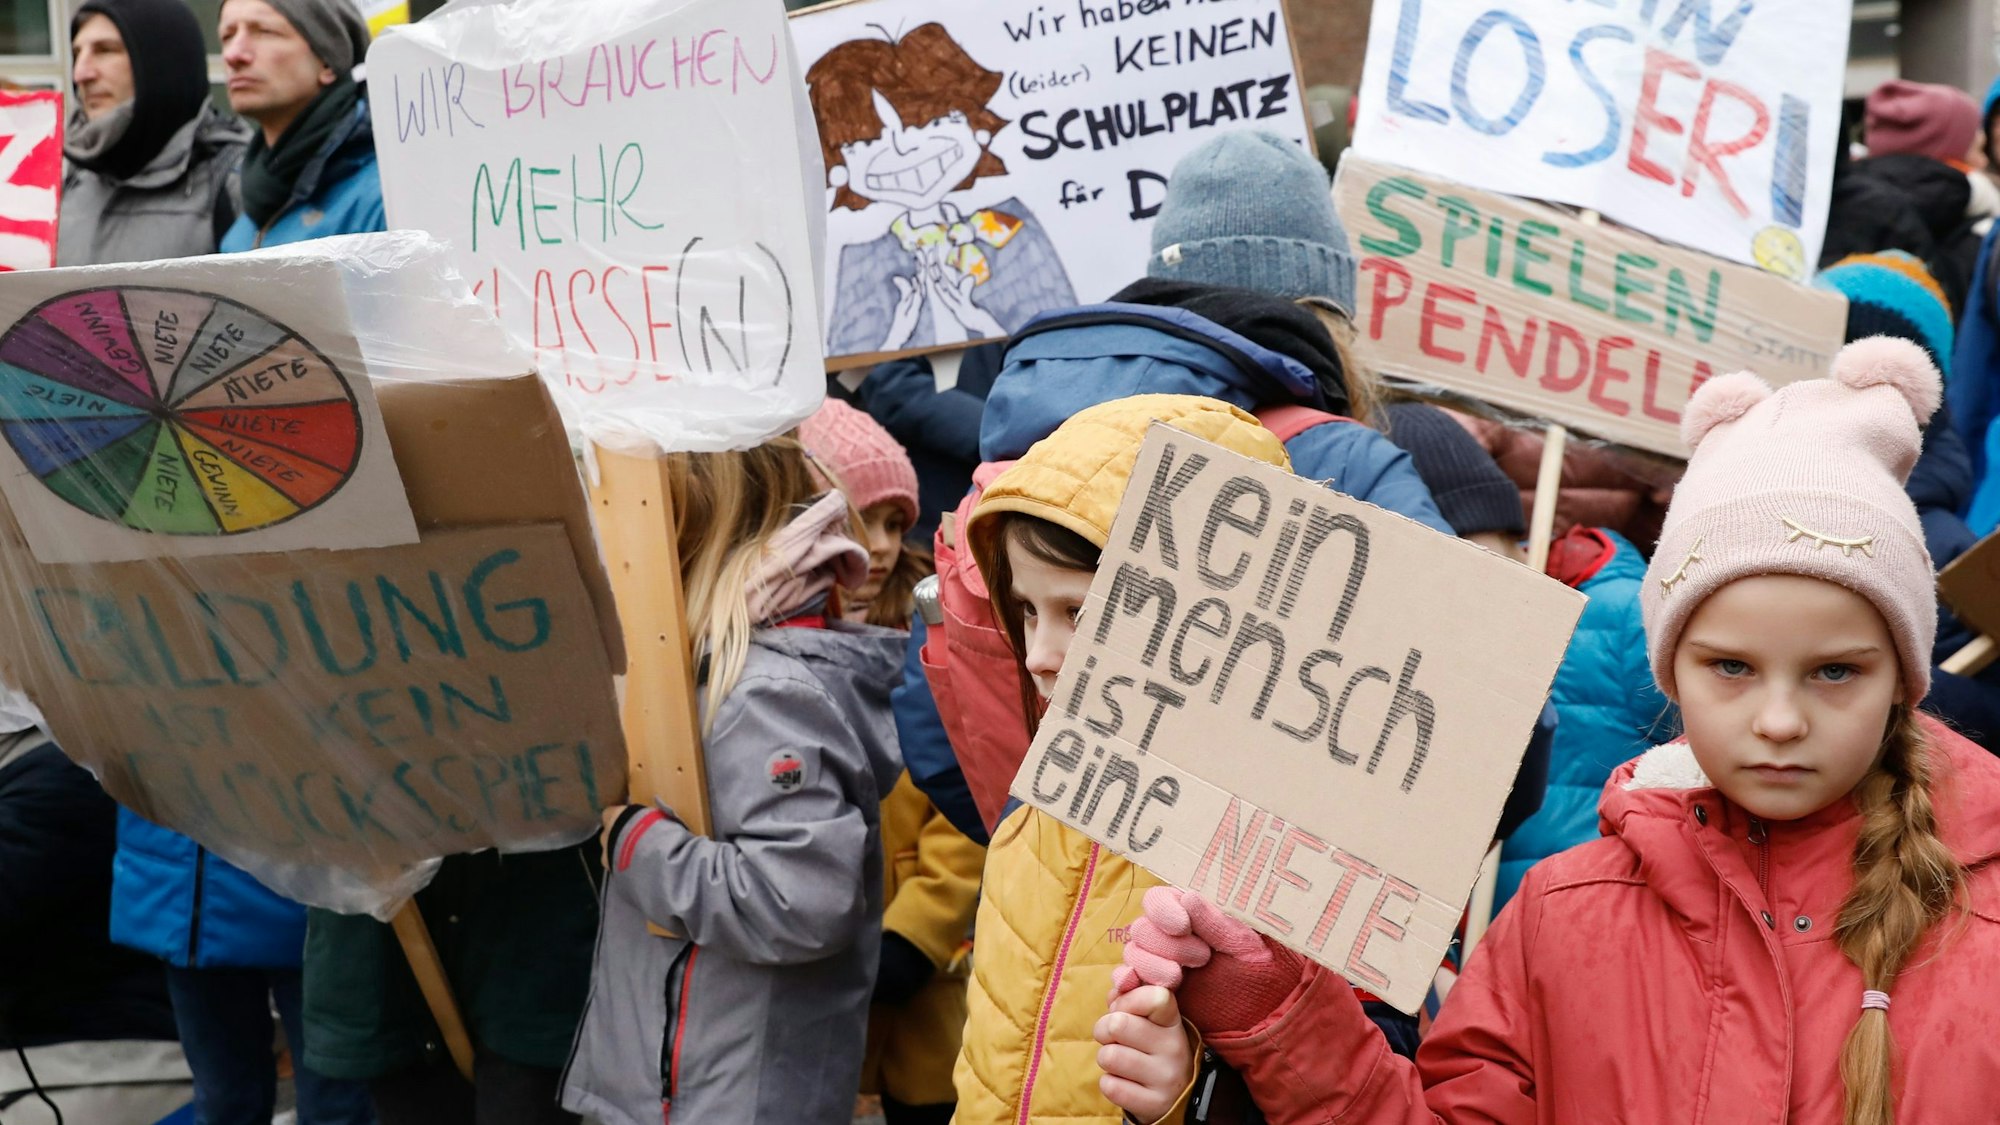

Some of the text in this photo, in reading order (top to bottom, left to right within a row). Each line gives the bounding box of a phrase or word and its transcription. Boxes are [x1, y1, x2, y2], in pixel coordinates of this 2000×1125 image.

[1004, 7, 1066, 42] Wir
[1115, 12, 1276, 73] KEINEN
[395, 29, 777, 143] WIR BRAUCHEN
[1019, 74, 1291, 160] SCHULPLATZ
[473, 143, 664, 251] MEHR
[1359, 177, 1722, 343] SPIELEN
[154, 310, 179, 366] NIETE
[473, 236, 793, 394] ASSE(N)
[189, 323, 244, 375] NIETE
[222, 357, 308, 404] NIETE
[220, 413, 305, 434] NIETE
[155, 452, 182, 514] NIETE
[193, 449, 241, 516] GEWINN
[221, 439, 304, 483] NIETE
[1031, 728, 1181, 853] eine
